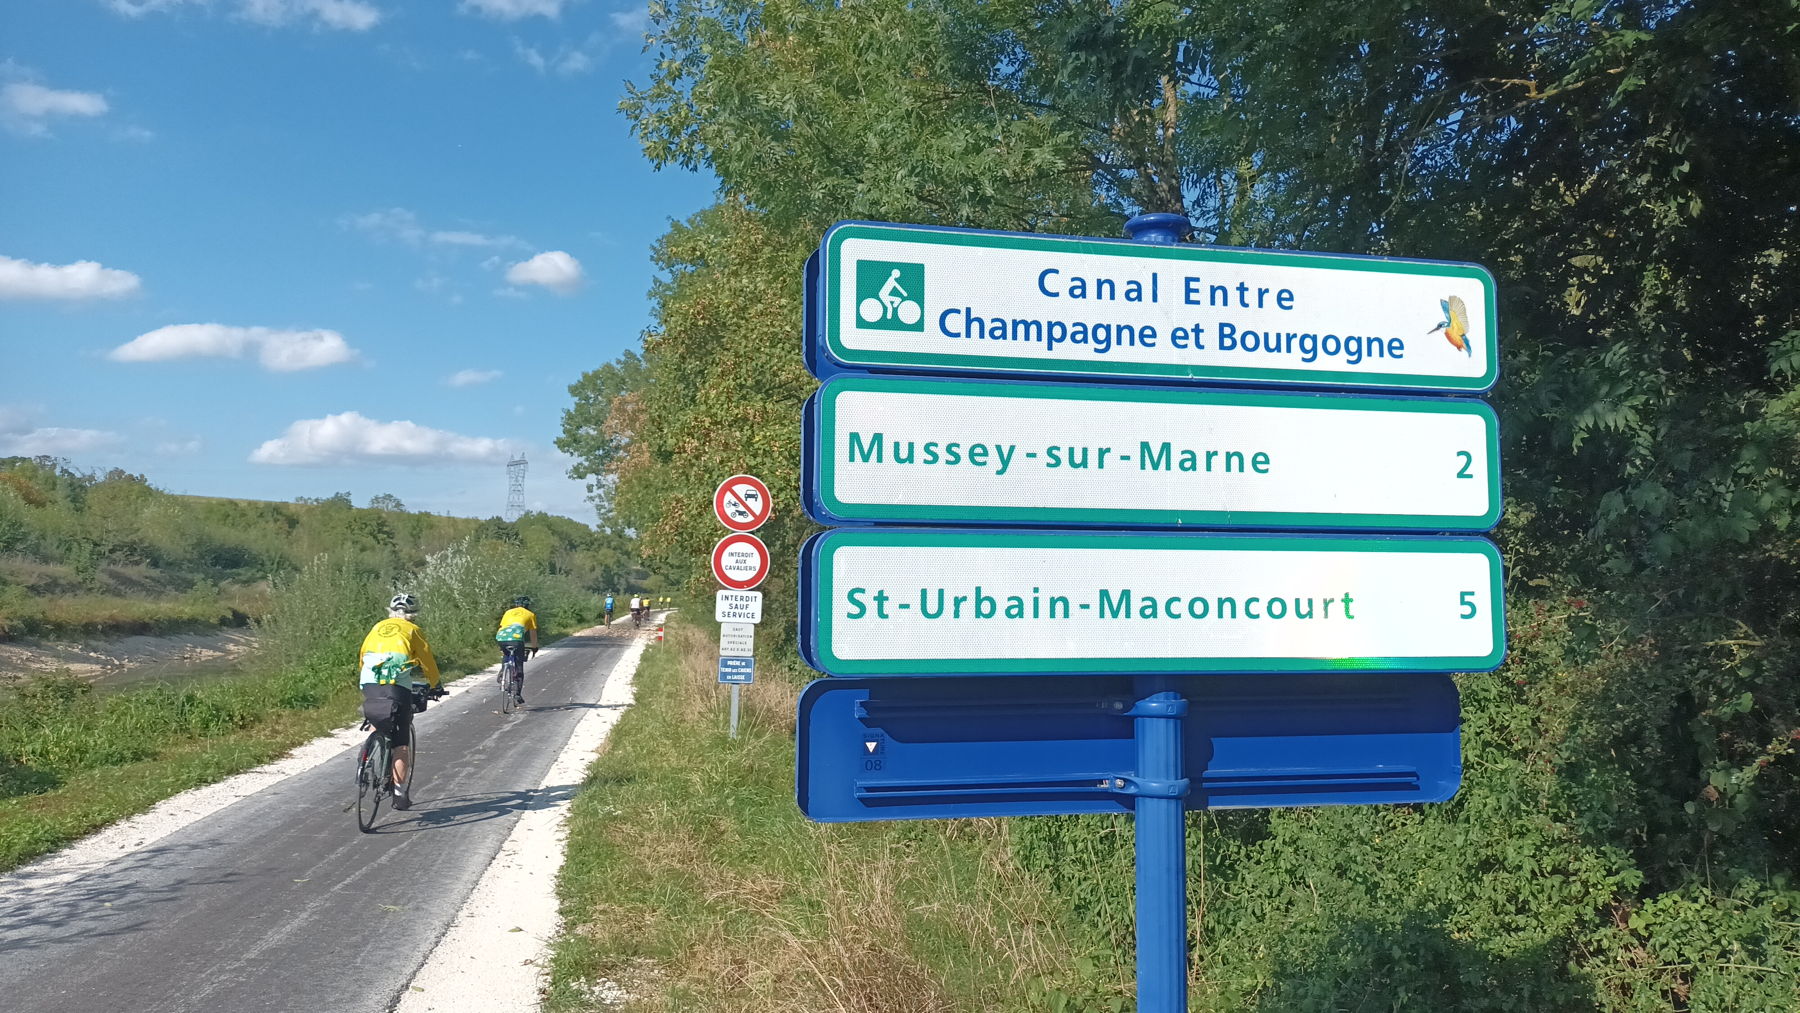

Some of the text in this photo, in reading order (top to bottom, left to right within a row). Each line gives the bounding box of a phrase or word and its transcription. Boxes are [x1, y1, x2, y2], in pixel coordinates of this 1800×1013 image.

[1038, 268, 1294, 310] Canal Entre
[939, 307, 1405, 365] Champagne et Bourgogne
[848, 432, 1474, 479] Mussey-sur-Marne 2
[722, 611, 756, 619] SERVICE
[846, 586, 1477, 620] St-Urbain-Maconcourt 5
[865, 759, 882, 771] 08
